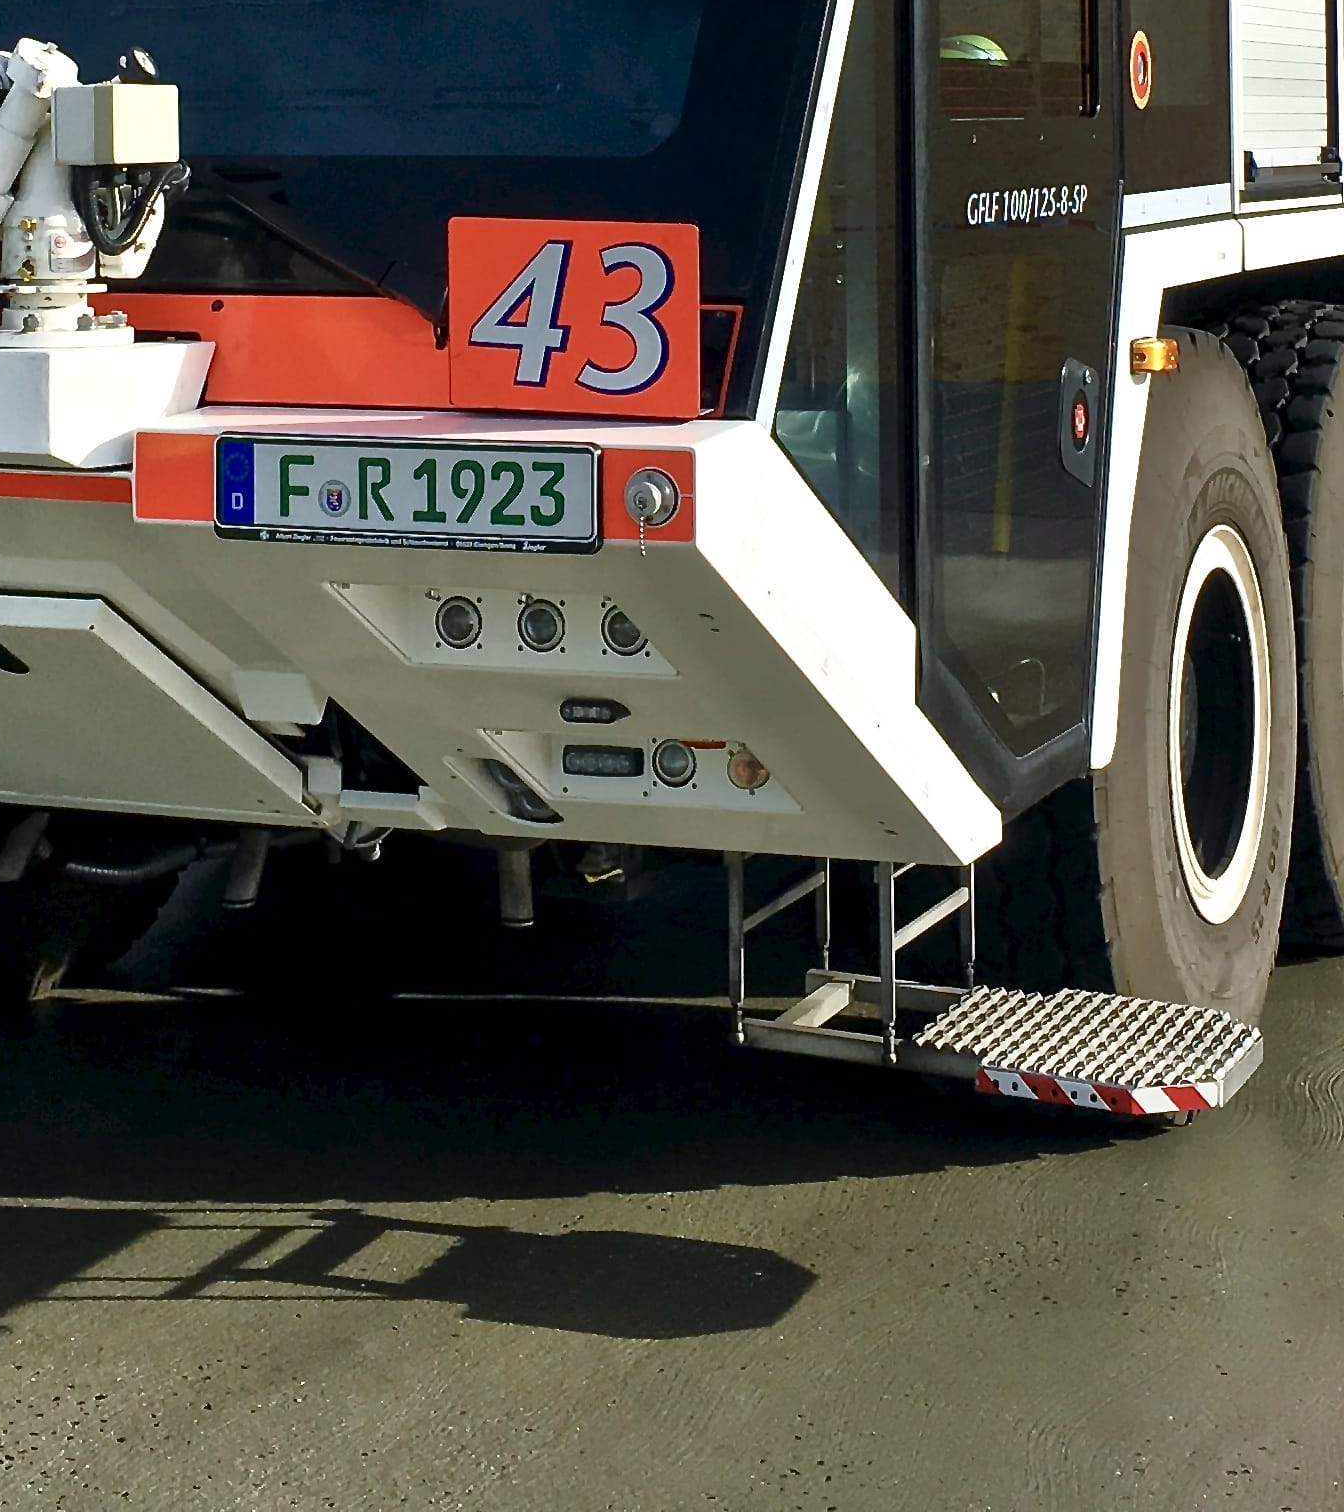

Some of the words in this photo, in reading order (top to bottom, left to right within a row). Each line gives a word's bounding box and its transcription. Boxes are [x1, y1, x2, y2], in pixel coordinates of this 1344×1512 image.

[967, 191, 1000, 225] GFLF
[469, 240, 676, 396] 43
[231, 492, 244, 511] D
[279, 454, 315, 518] F
[358, 456, 395, 522] R
[412, 458, 566, 527] 1923
